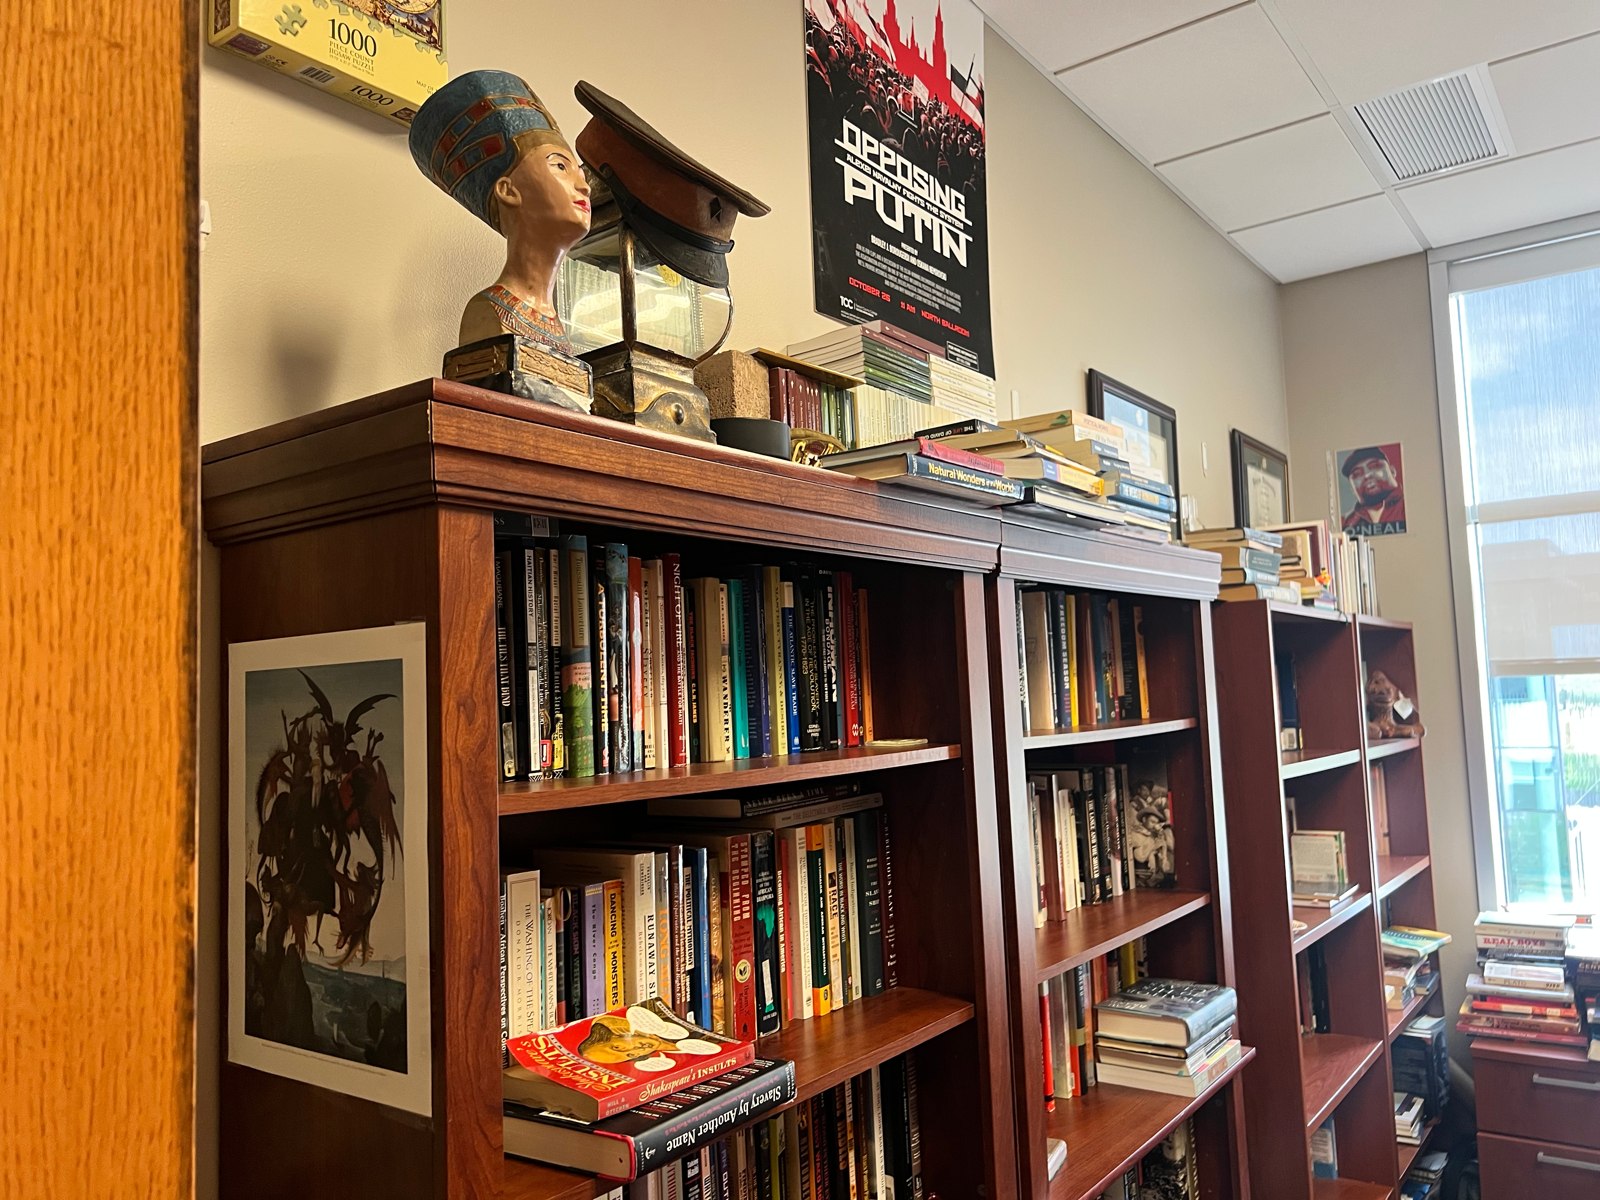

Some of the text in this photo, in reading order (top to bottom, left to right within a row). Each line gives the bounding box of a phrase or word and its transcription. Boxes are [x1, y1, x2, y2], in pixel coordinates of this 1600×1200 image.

[328, 18, 377, 58] 1000
[330, 40, 348, 54] PIECE
[350, 50, 374, 66] COUNT
[329, 47, 352, 61] JIGSAW
[352, 57, 374, 72] PUZZLE
[350, 85, 394, 106] 1000
[841, 118, 968, 222] OPPOSING
[846, 153, 872, 176] ALEXEI
[873, 168, 901, 193] NAVALNY
[902, 186, 925, 207] FIGHTS
[940, 209, 964, 230] SYSTEM
[839, 163, 969, 268] PUTIN
[840, 295, 854, 310] TCC
[848, 276, 970, 338] OCTOBER AM NORTH BALLROOM
[930, 431, 945, 440] DAVID
[944, 428, 952, 437] OF
[928, 462, 956, 480] Natural
[956, 469, 986, 487] Wonders
[996, 478, 1014, 493] World
[1344, 522, 1406, 536] O'NEAL
[576, 557, 585, 641] Toussaint Louverture
[598, 583, 605, 594] A
[804, 598, 810, 606] IN
[674, 604, 681, 618] OF
[807, 644, 812, 654] OF
[827, 586, 838, 702] INHUMAN
[500, 664, 509, 686] THAT
[813, 658, 818, 669] OF
[502, 687, 511, 707] BIND
[808, 657, 816, 713] REVOLUTION,
[722, 676, 730, 742] WANDERER
[740, 842, 749, 886] STAMPED
[732, 869, 741, 922] BEGINNING
[525, 920, 534, 970] WASHING
[647, 914, 655, 976] RUNAWAY
[659, 908, 669, 959] LONG
[780, 933, 785, 941] in
[1483, 938, 1546, 946] REAL BOYS
[526, 972, 534, 986] OF
[501, 1018, 506, 1028] on
[516, 1040, 612, 1092] Shakespeare's
[532, 1034, 628, 1088] INSULTS
[638, 1069, 697, 1102] Shakespeare's
[698, 1057, 737, 1079] INSULTS
[607, 1099, 620, 1108] HILL
[666, 1086, 781, 1152] Slavery by Another Name
[801, 1160, 810, 1200] TURNE
